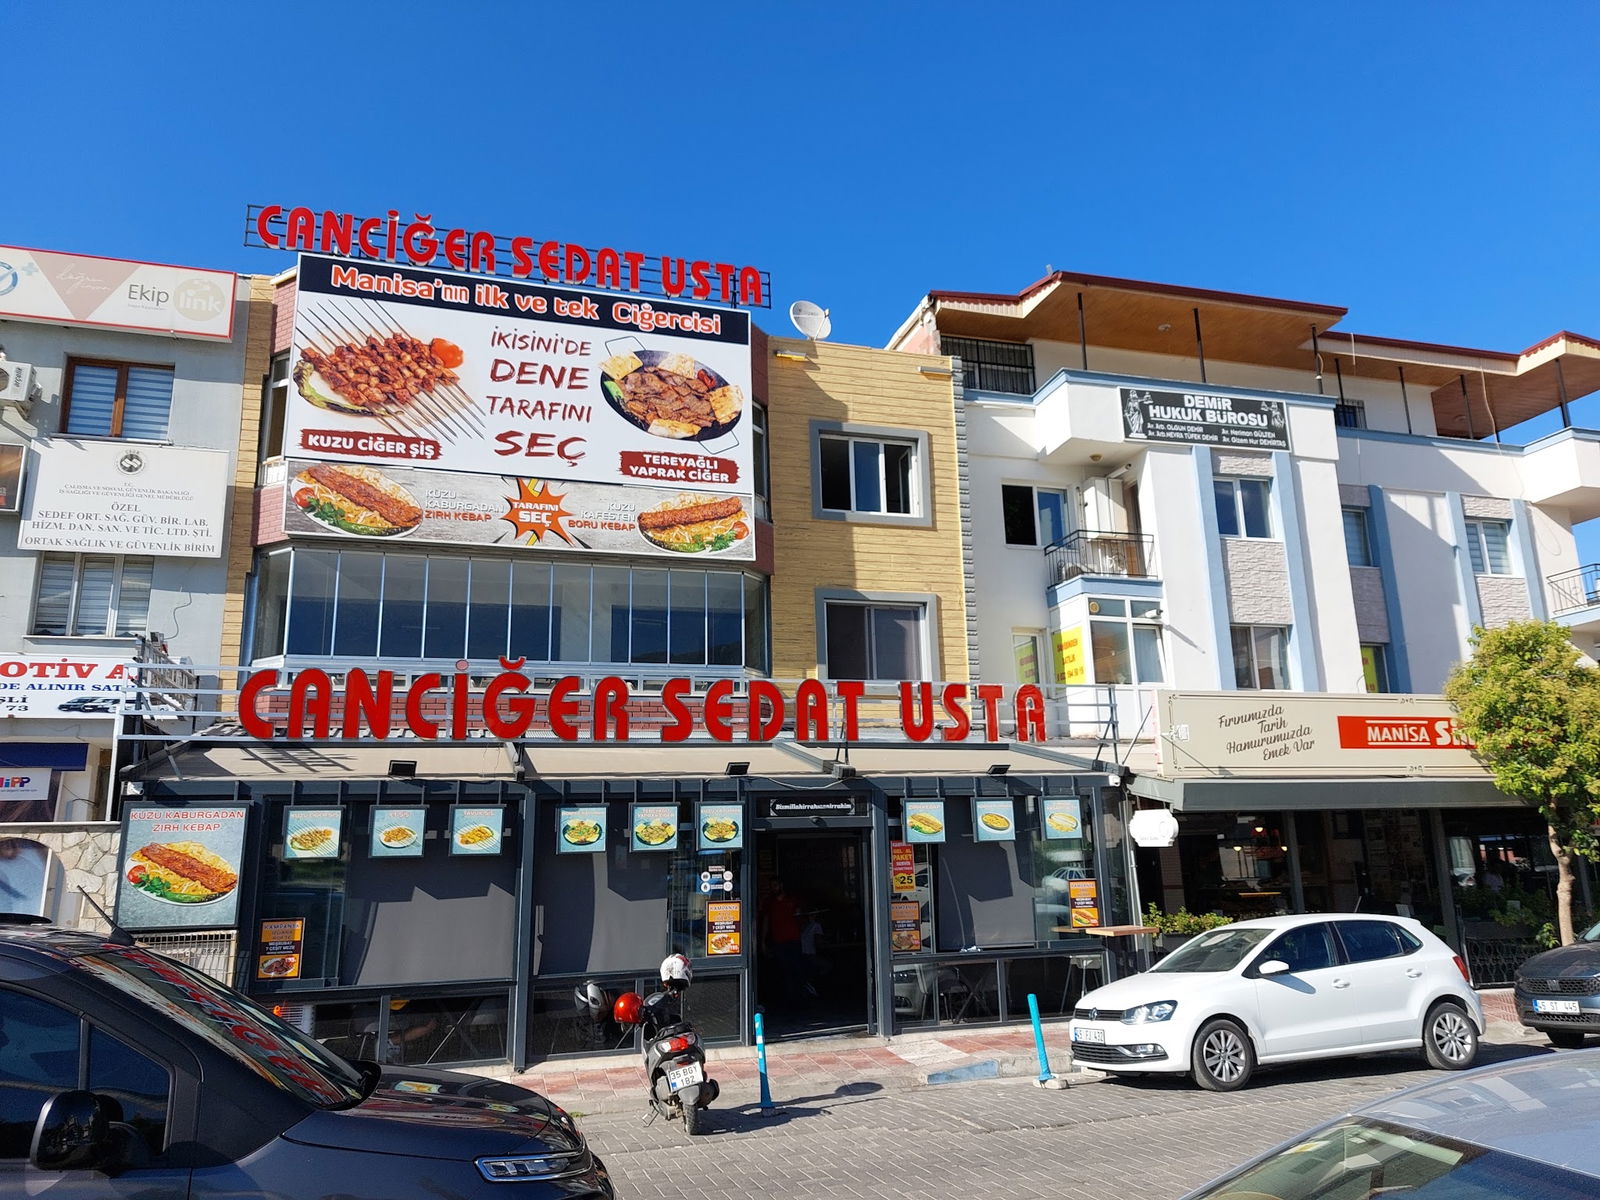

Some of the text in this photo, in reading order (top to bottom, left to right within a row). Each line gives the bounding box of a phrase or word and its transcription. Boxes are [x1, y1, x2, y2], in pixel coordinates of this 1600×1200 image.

[257, 205, 763, 305] CANCİĞER SEDAT USTA
[128, 284, 169, 306] Ekip
[474, 283, 509, 310] ilk
[514, 294, 547, 313] ve
[553, 295, 600, 321] tek
[612, 302, 721, 335] Ciğercisi
[491, 326, 592, 356] İKİSİNİ'DE
[490, 358, 590, 390] DENE
[486, 395, 592, 423] TARAFINI
[1149, 405, 1268, 427] HUKUK BÜROSU
[308, 434, 435, 460] KUZU CİĞER ŞİŞ
[494, 430, 588, 467] SEÇ
[643, 454, 718, 470] TEREYAĞLI
[629, 465, 729, 483] YAPRAK CİĞER
[425, 488, 456, 499] KUZU
[111, 501, 141, 512] ÖZEL
[425, 500, 504, 514] KABURGADAN
[512, 502, 559, 512] TARAFINI
[607, 502, 636, 512] KUZU
[38, 510, 209, 527] SEDEF ORT. SAĞ. GÜV. BİR. LAB.
[424, 510, 493, 523] ZIRH KEBAP
[518, 511, 552, 528] SEÇ
[581, 510, 636, 522] KAFESTEN
[31, 520, 213, 539] HİZM. DAN. SAN. VE TİC. LTD. ŞTİ.
[568, 519, 636, 531] BORU KEBAP
[24, 536, 216, 553] ORTAK SAĞLIK VE GÜVENLİK BİRİM
[26, 683, 85, 691] ALINIR
[238, 655, 1048, 743] CANCİĞER SEDAT USTA
[1257, 717, 1288, 734] Tarih
[1367, 724, 1431, 742] MANİSA
[1227, 724, 1312, 754] Hamurumuzda
[1263, 739, 1315, 760] Emek Var
[131, 811, 245, 820] KUZU KABURGADAN
[153, 823, 221, 832] ZIRH KEBAP
[670, 1071, 681, 1080] 35
